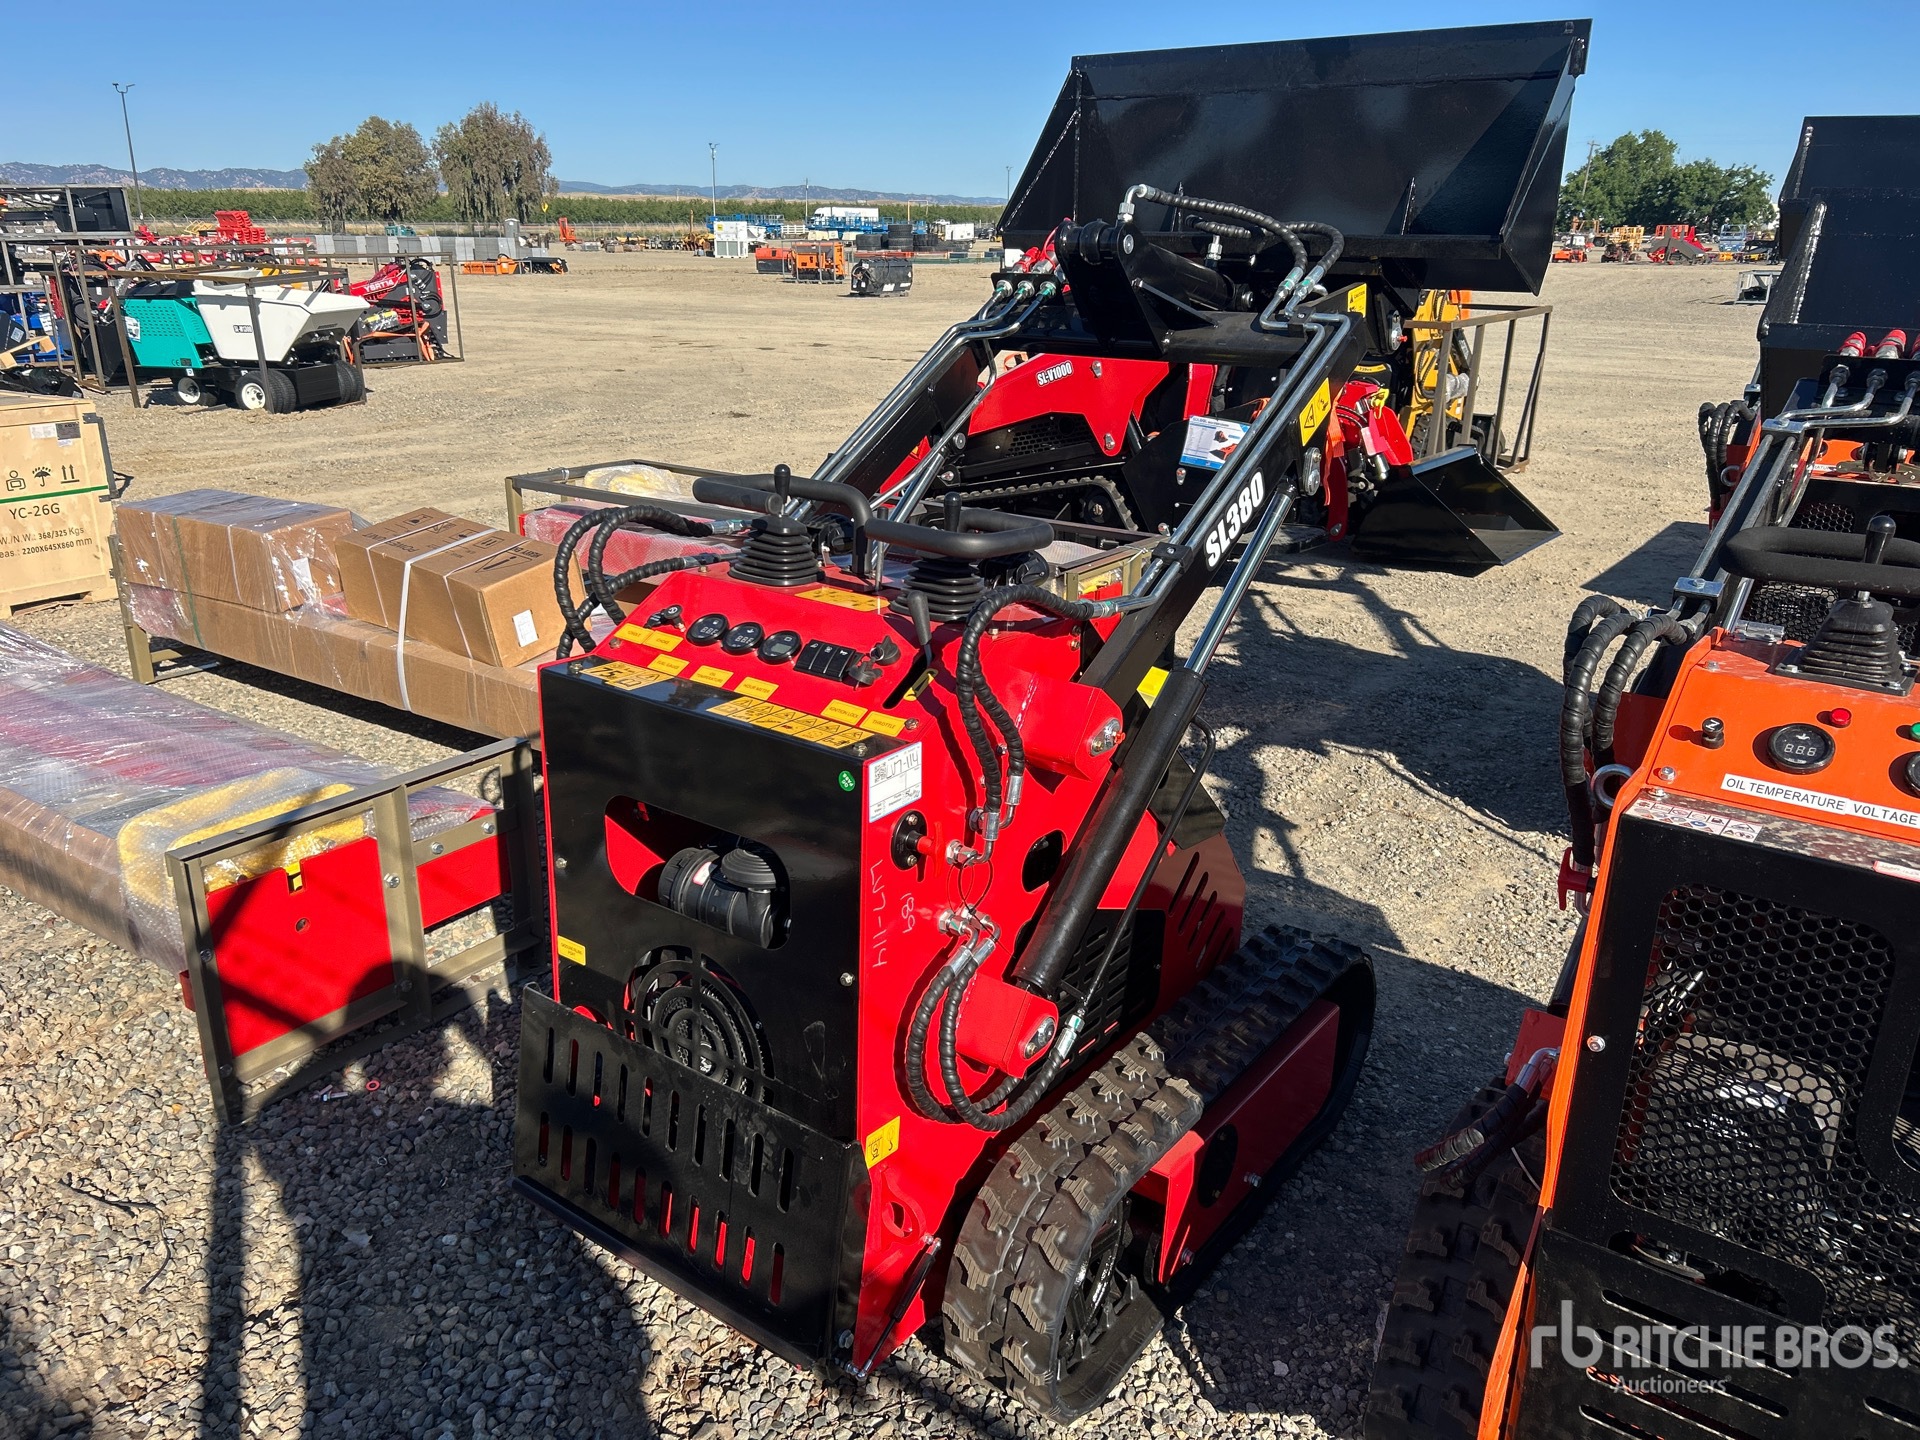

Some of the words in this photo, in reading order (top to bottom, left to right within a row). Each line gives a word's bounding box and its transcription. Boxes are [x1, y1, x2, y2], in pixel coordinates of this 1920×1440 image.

[1037, 362, 1073, 386] SL-V1000
[9, 503, 60, 519] YC-26G
[1206, 472, 1264, 567] SL380
[38, 530, 67, 540] 368/325
[68, 527, 84, 536] Kgs
[22, 541, 74, 555] 2200X645X860
[75, 538, 92, 546] mm
[829, 706, 848, 716] IGNITION
[872, 719, 896, 729] THROTTLE
[1726, 777, 1746, 791] OIL
[1749, 782, 1846, 811] TEMPERATURE
[1853, 803, 1919, 826] VOLTAGE
